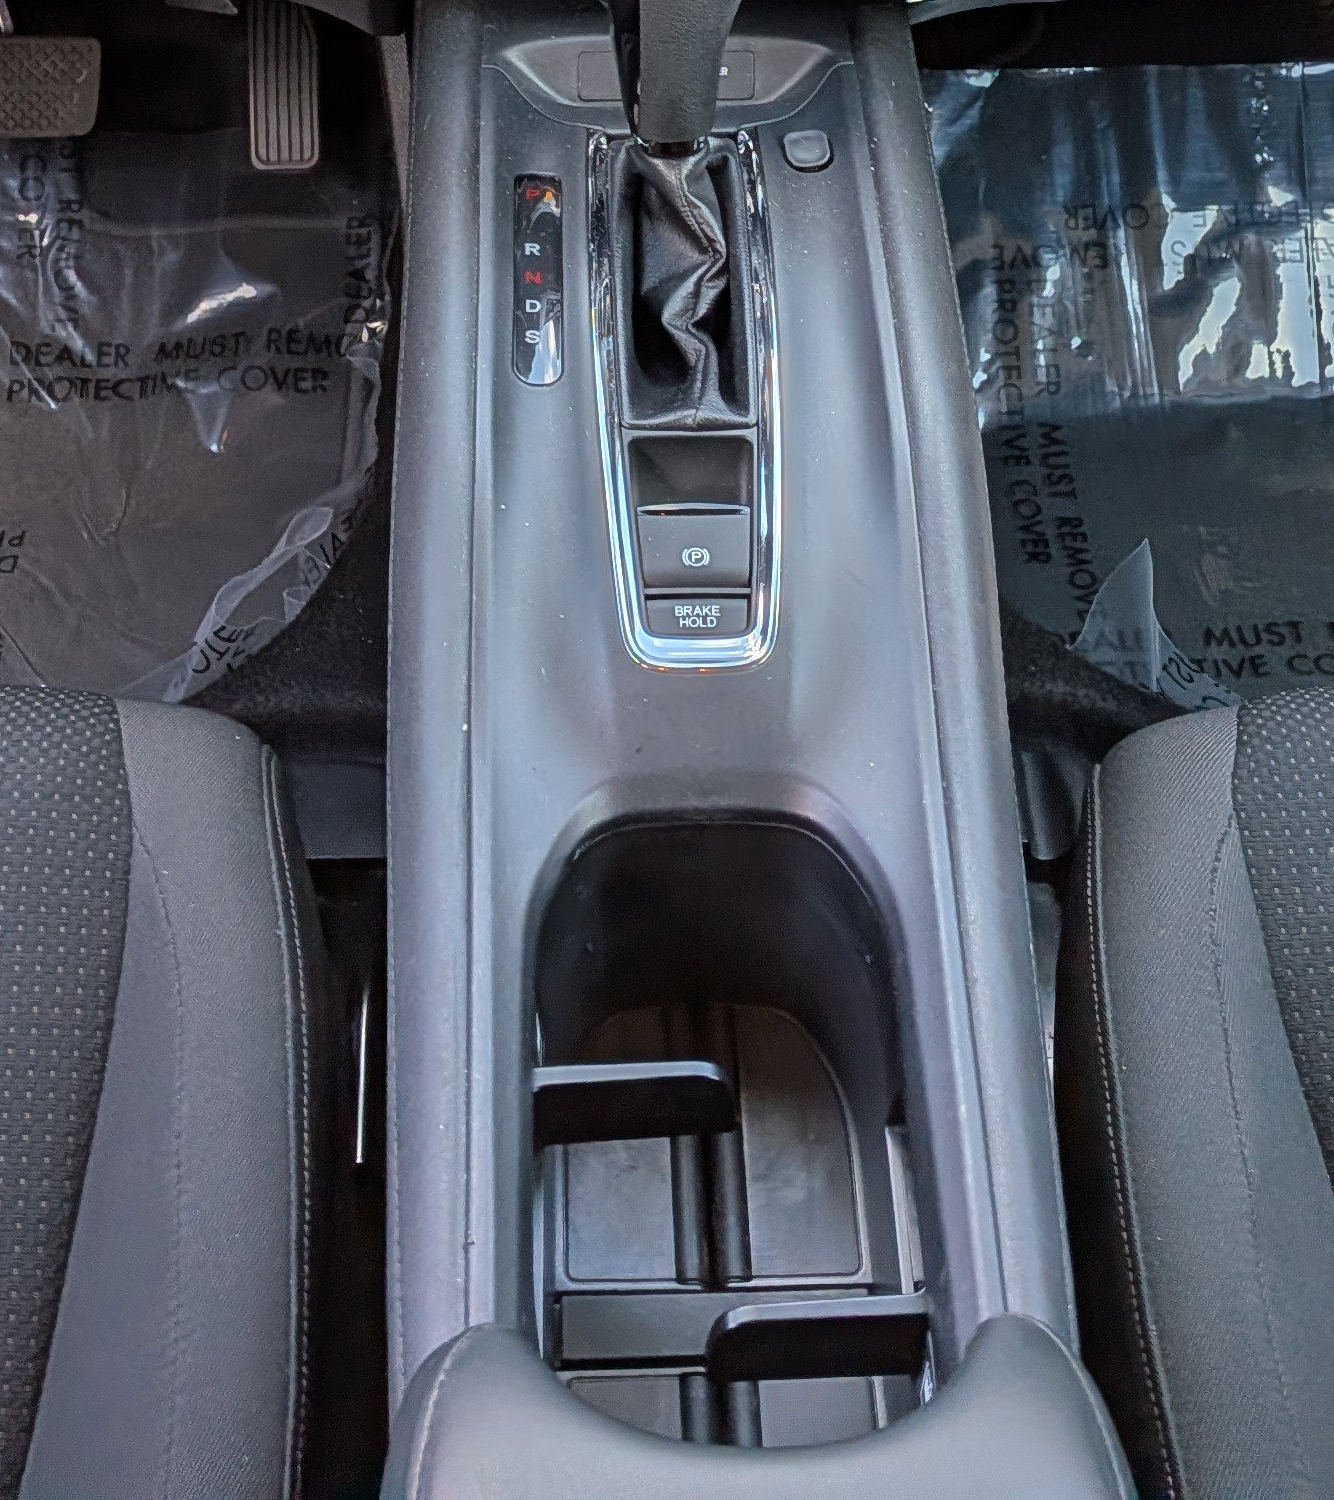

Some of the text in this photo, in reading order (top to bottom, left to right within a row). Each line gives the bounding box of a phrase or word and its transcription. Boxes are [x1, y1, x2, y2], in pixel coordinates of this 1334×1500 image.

[526, 189, 540, 202] P
[524, 242, 541, 256] R
[524, 271, 543, 286] N
[525, 300, 541, 313] D
[524, 329, 541, 344] S
[9, 339, 132, 368] DEALER
[154, 330, 247, 362] MUST
[7, 365, 329, 402] PROTECTIVE COVER
[992, 278, 1053, 566] PROTECTIVE COVER
[1036, 422, 1079, 501] MUST
[674, 604, 721, 618] BRAKE
[679, 616, 717, 629] HOLD
[1203, 620, 1303, 648] MUST
